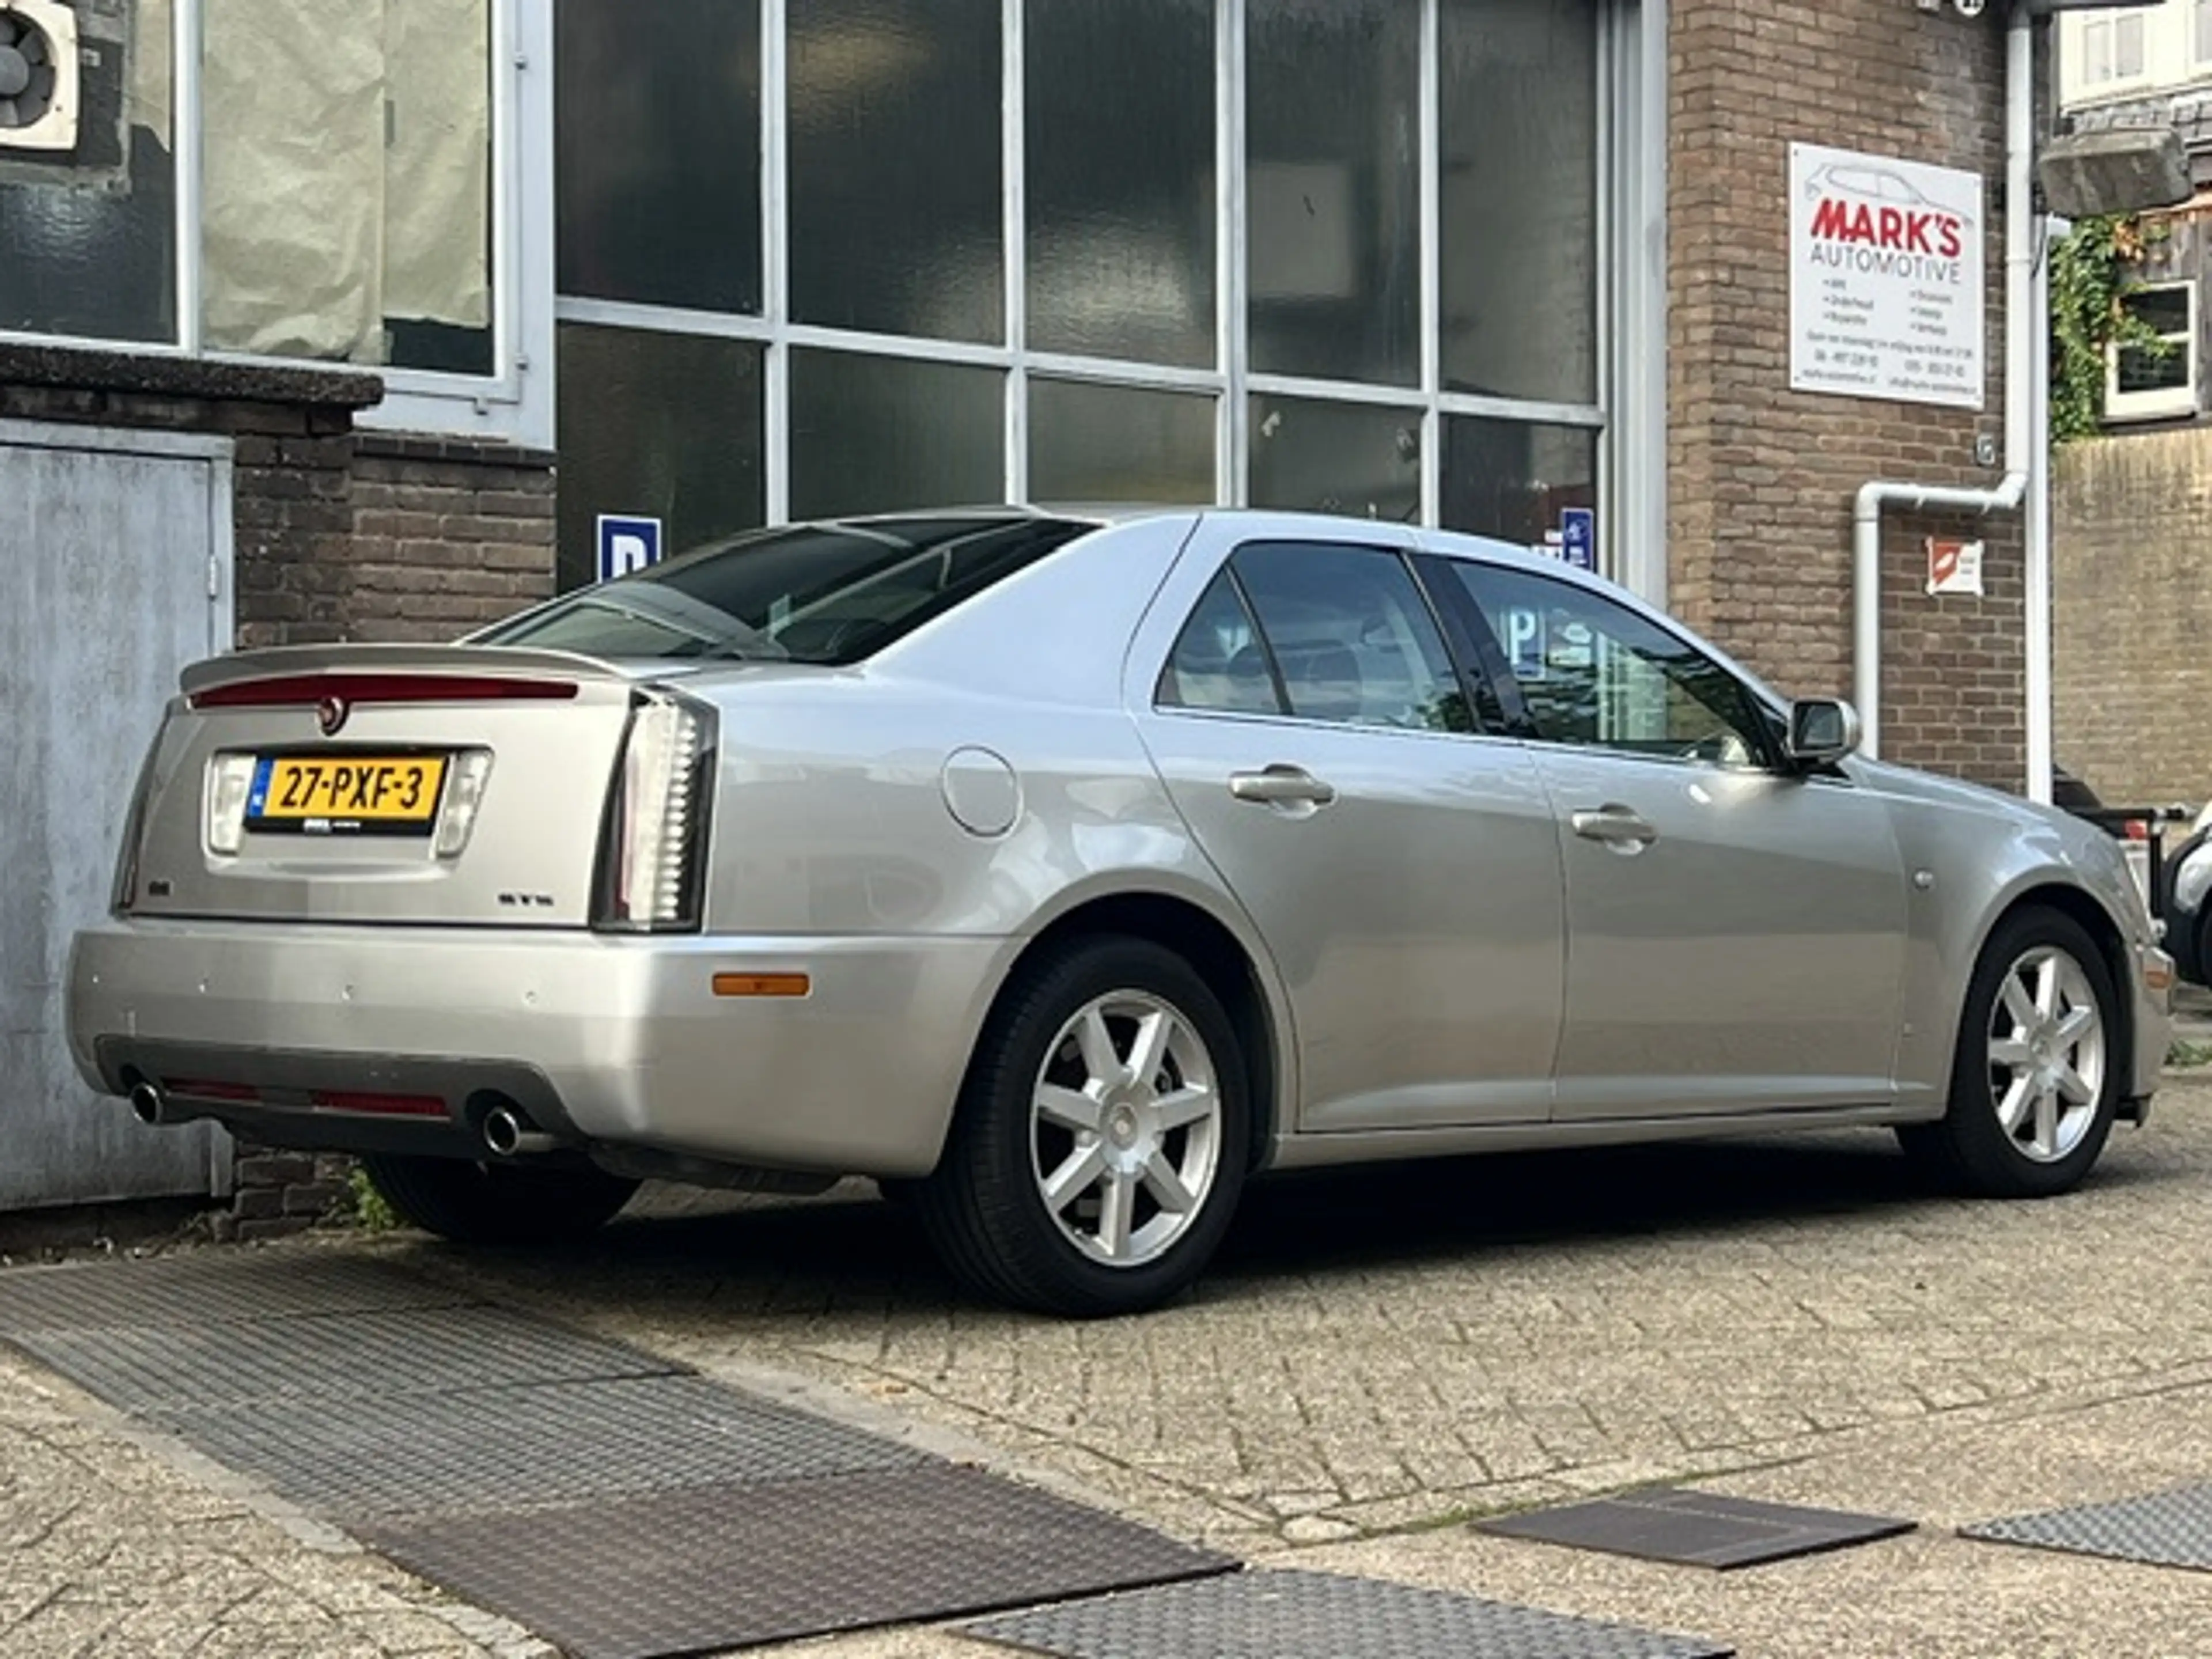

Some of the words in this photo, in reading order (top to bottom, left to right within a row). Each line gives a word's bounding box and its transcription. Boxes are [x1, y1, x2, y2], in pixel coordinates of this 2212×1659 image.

[1810, 198, 1961, 258] MARK'S
[1810, 243, 1961, 284] AUTOMOTIVE
[1510, 608, 1536, 665] P
[279, 766, 423, 810] 27-PXF-3
